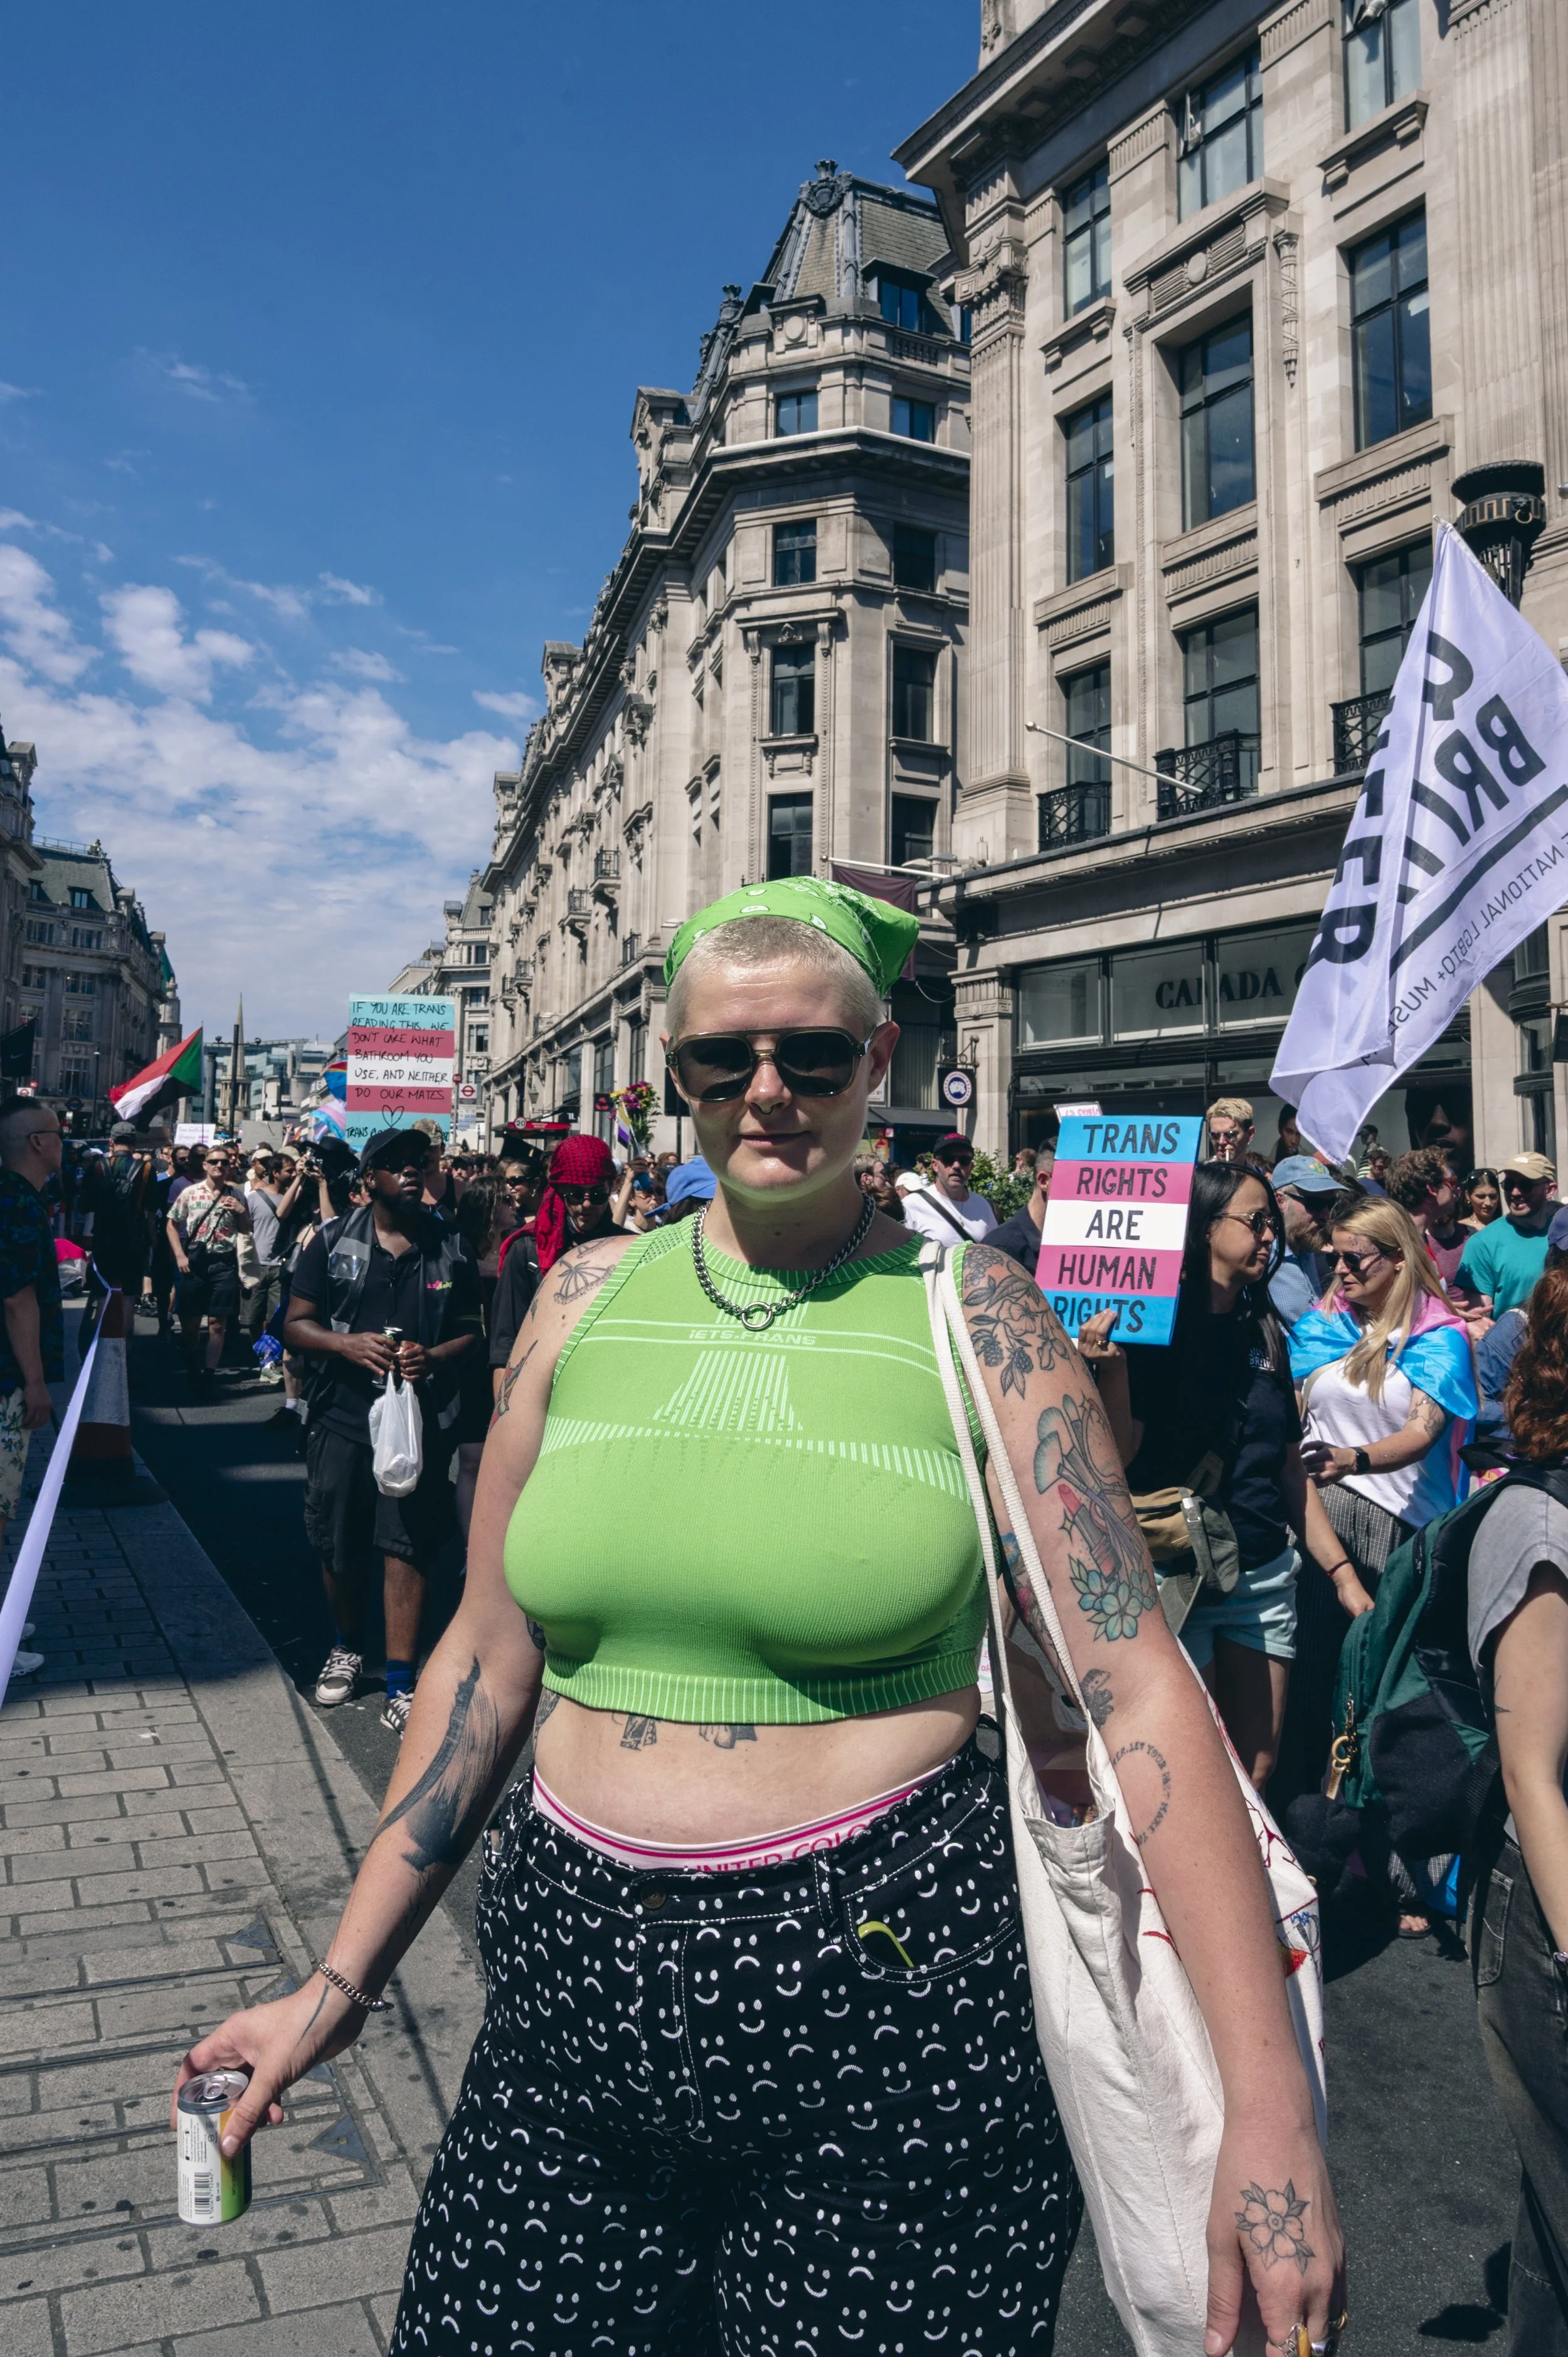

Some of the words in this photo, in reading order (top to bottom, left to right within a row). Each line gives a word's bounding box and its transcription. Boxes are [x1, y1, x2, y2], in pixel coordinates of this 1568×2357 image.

[352, 1001, 366, 1013] IF
[371, 1002, 388, 1014] YOU
[391, 1003, 410, 1016] ARE
[413, 1004, 447, 1015] TRANS
[351, 1018, 396, 1032] READING
[431, 1022, 449, 1030] WE
[383, 1033, 407, 1043] CARE
[411, 1035, 444, 1048] WHAT
[355, 1049, 410, 1061] BATHROOM
[414, 1053, 433, 1063] YOU
[383, 1070, 405, 1080] AND
[355, 1087, 371, 1098] DO
[380, 1088, 405, 1099] OUR
[408, 1089, 445, 1100] MATES
[346, 1127, 369, 1139] TRANS
[1083, 1122, 1180, 1154] TRANS
[1076, 1167, 1168, 1198] RIGHTS
[1085, 1209, 1144, 1240] ARE
[1057, 1253, 1157, 1290] HUMAN
[1147, 1744, 1167, 1770] YOUR
